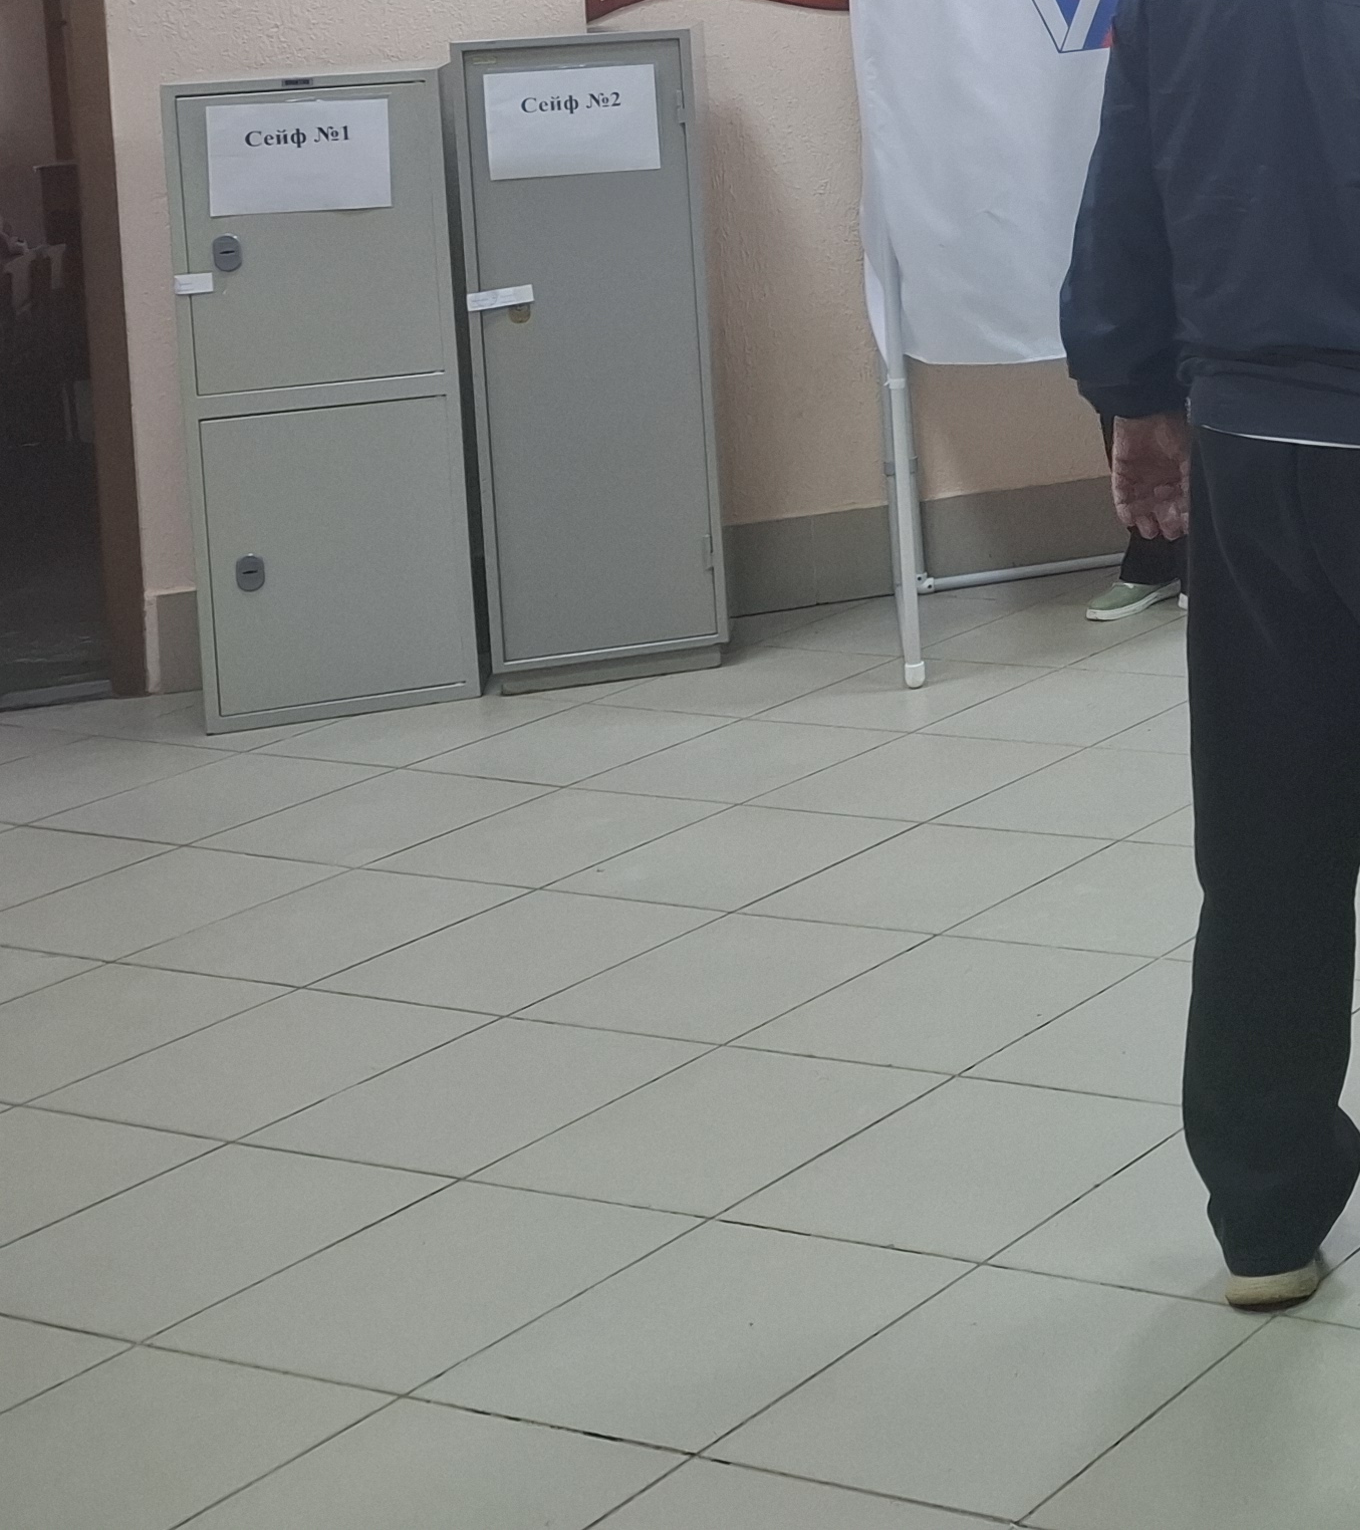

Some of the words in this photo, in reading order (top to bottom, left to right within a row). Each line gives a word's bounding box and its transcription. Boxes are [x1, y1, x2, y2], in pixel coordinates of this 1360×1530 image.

[521, 95, 579, 115] Сейф
[586, 92, 622, 109] №2
[244, 128, 307, 149] Сейф
[314, 125, 350, 143] №1
